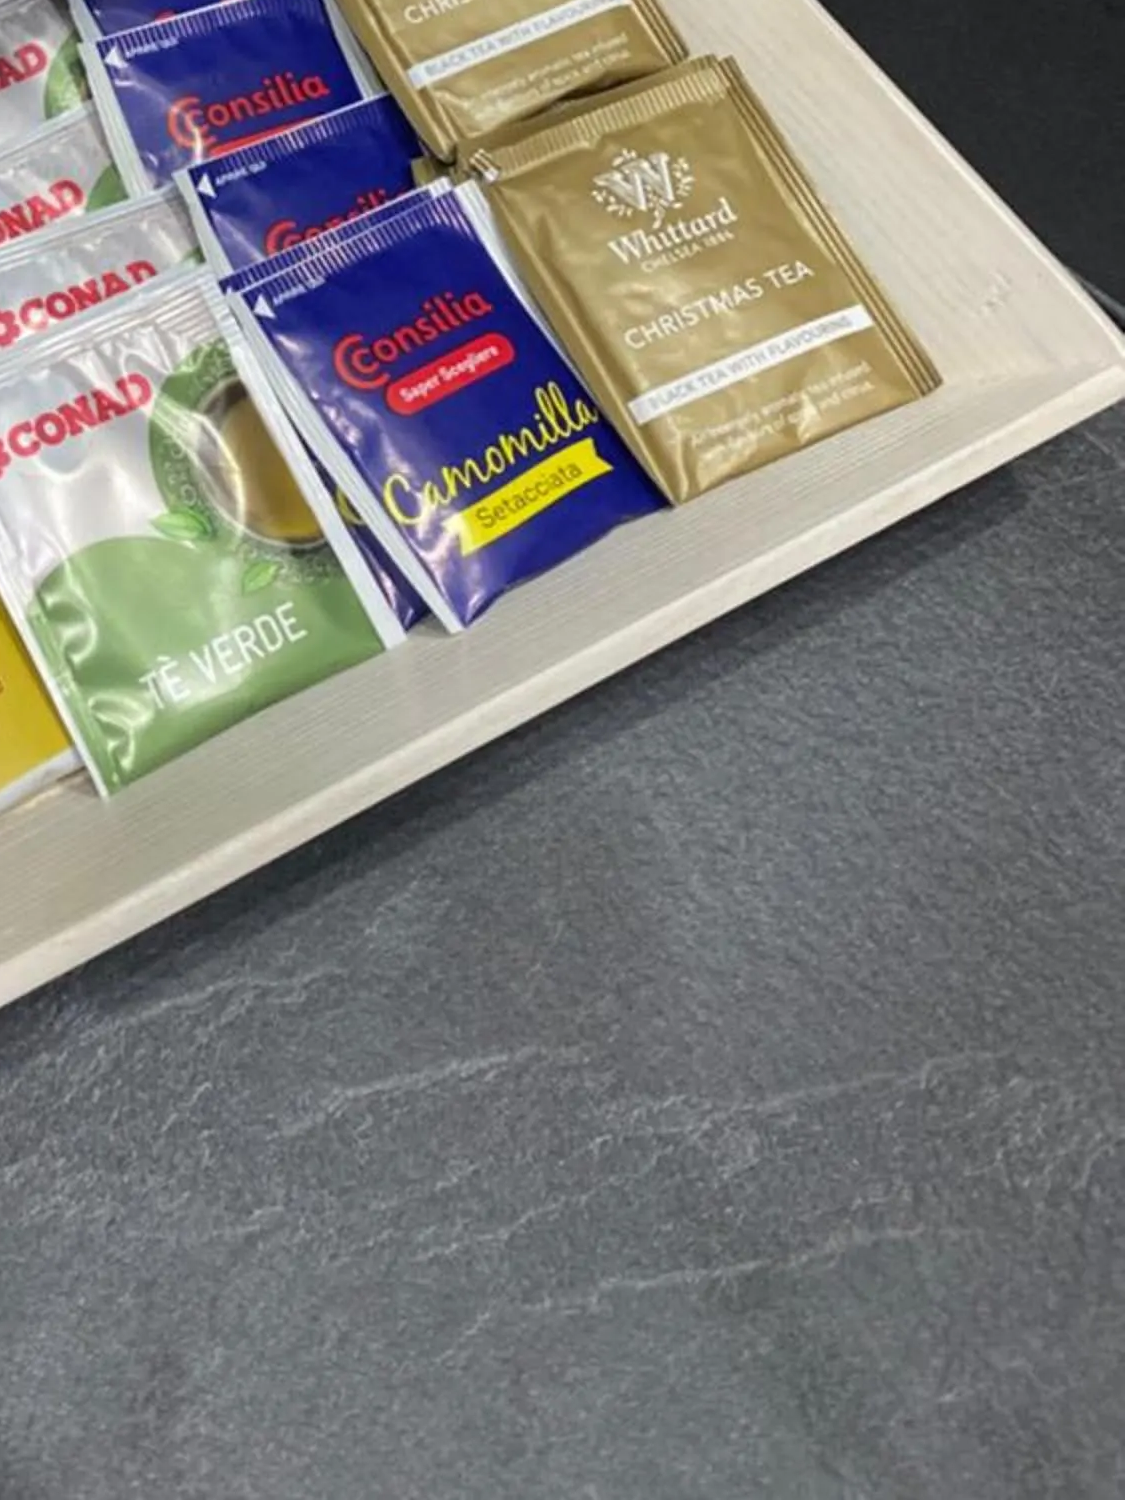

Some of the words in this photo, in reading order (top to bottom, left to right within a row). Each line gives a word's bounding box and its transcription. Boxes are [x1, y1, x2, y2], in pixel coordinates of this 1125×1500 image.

[167, 71, 330, 148] Consilia
[607, 196, 738, 264] Whittard
[19, 260, 158, 331] CONAD
[624, 277, 764, 350] CHRISTMAS
[763, 259, 816, 289] TEA
[333, 291, 494, 390] Consilia
[648, 383, 697, 410] BLACK
[699, 367, 726, 390] TEA
[727, 350, 766, 375] WITH
[766, 314, 853, 360] FLAVOURING
[7, 373, 153, 460] CONAD
[382, 380, 598, 525] Camomilla
[475, 461, 583, 530] Setacciata
[138, 655, 192, 710] TÈ
[188, 601, 308, 685] VERDE
